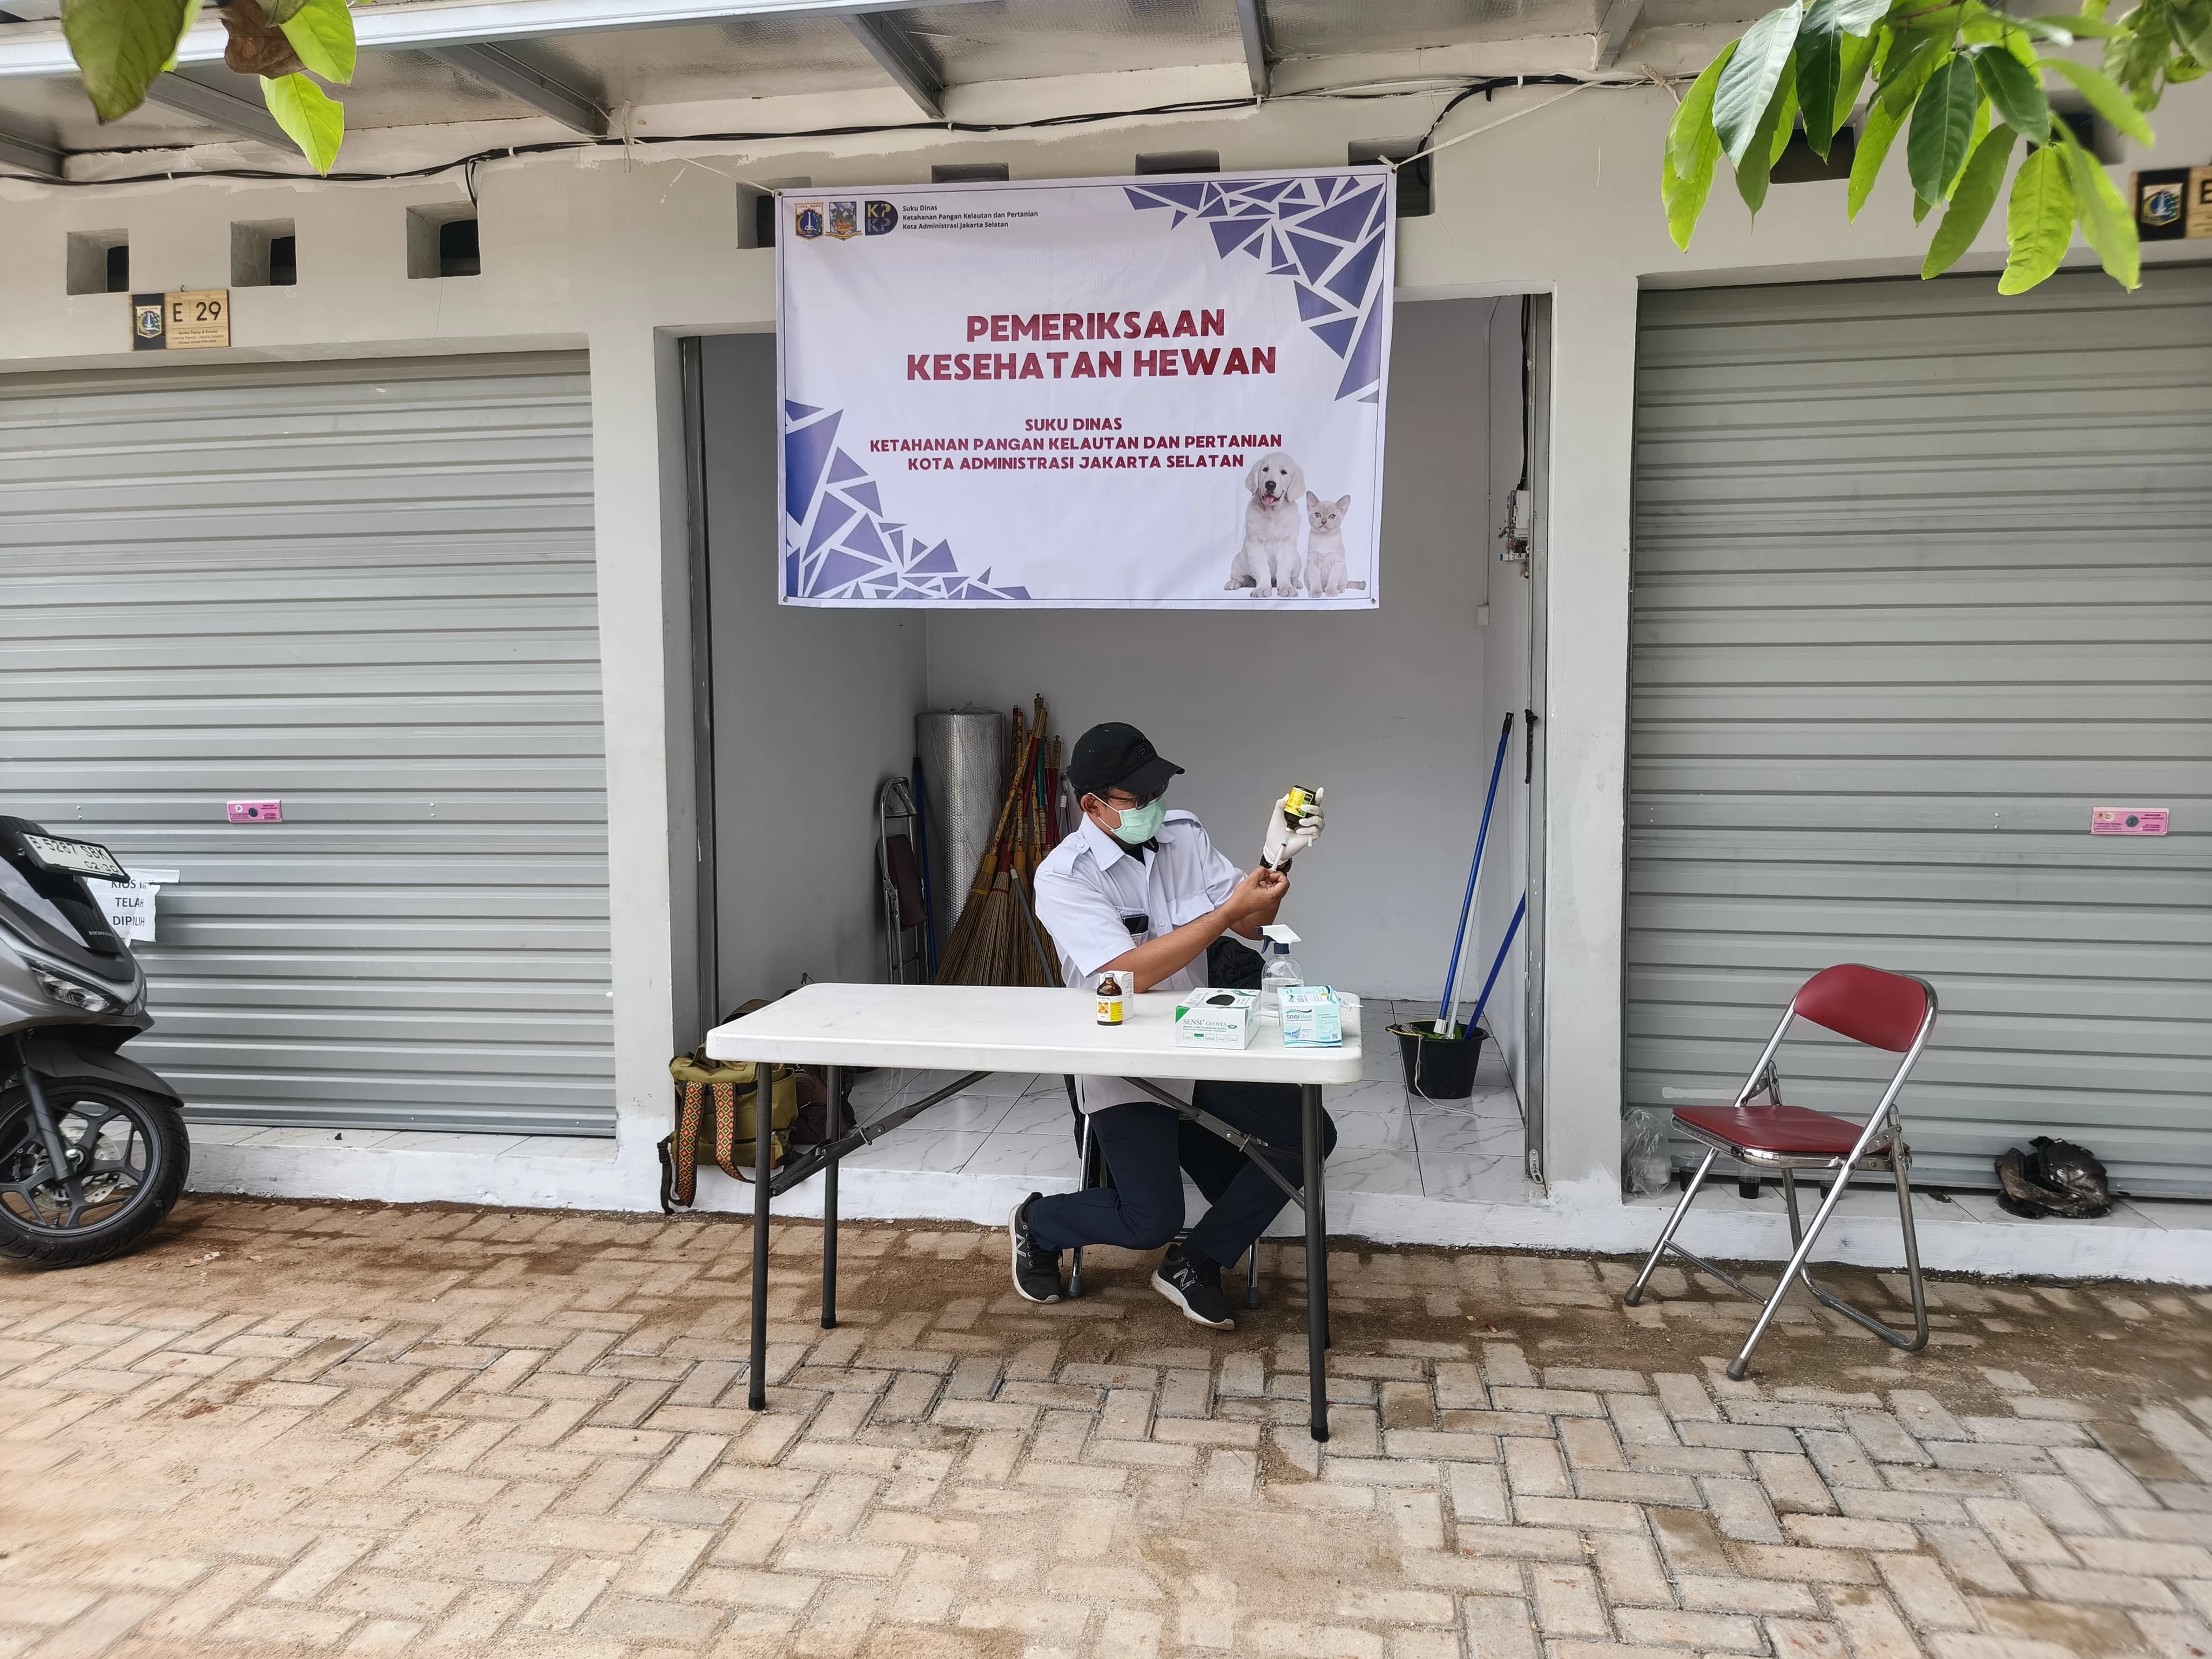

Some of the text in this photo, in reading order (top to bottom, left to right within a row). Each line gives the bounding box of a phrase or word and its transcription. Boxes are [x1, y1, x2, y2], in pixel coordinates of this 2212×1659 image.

[173, 301, 221, 322] E 29
[967, 309, 1225, 342] PEMERIKSAAN
[907, 347, 1276, 380] KESEHATAN HEWAN
[1026, 417, 1122, 431] SUKU DINAS
[870, 434, 1282, 452] KETAHANAN PANGAN KELAUTAN DAN PERTANIAN
[908, 454, 1244, 470] KOTA ADMINISTRASI JAKARTA SELATAN
[80, 845, 109, 860] SBK
[115, 897, 144, 908] TELAH
[113, 915, 145, 927] DIPILIH
